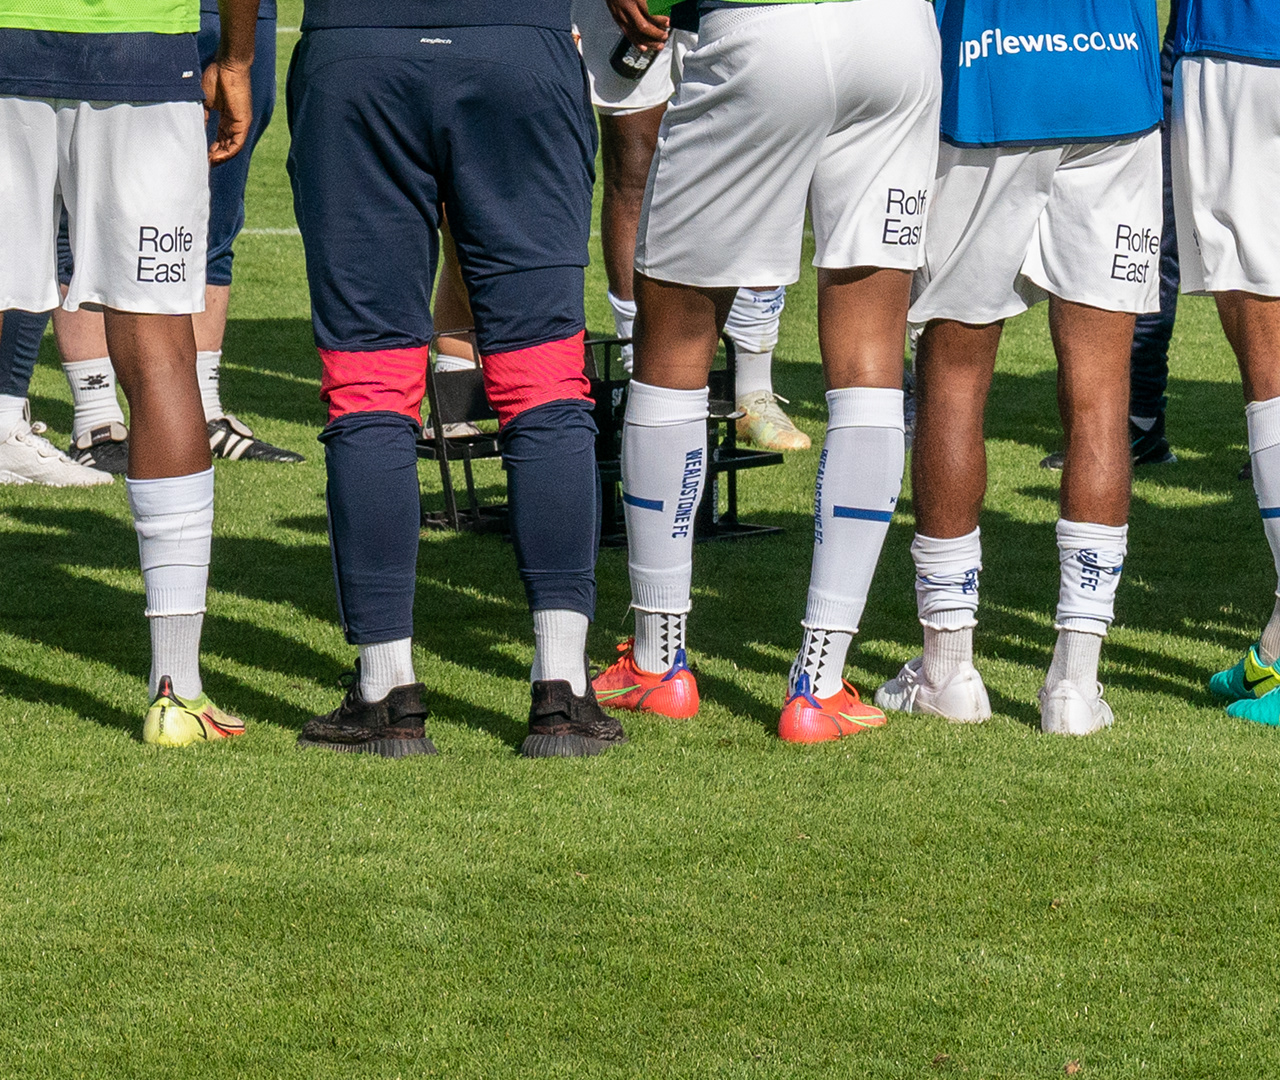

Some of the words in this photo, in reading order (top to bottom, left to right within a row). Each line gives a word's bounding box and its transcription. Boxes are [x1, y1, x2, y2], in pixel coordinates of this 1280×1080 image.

[138, 225, 193, 254] Rolfe
[1115, 224, 1160, 256] Rolfe
[136, 256, 187, 283] East
[1110, 253, 1150, 284] East
[674, 447, 704, 524] WEALDSTONE
[671, 523, 690, 539] FC
